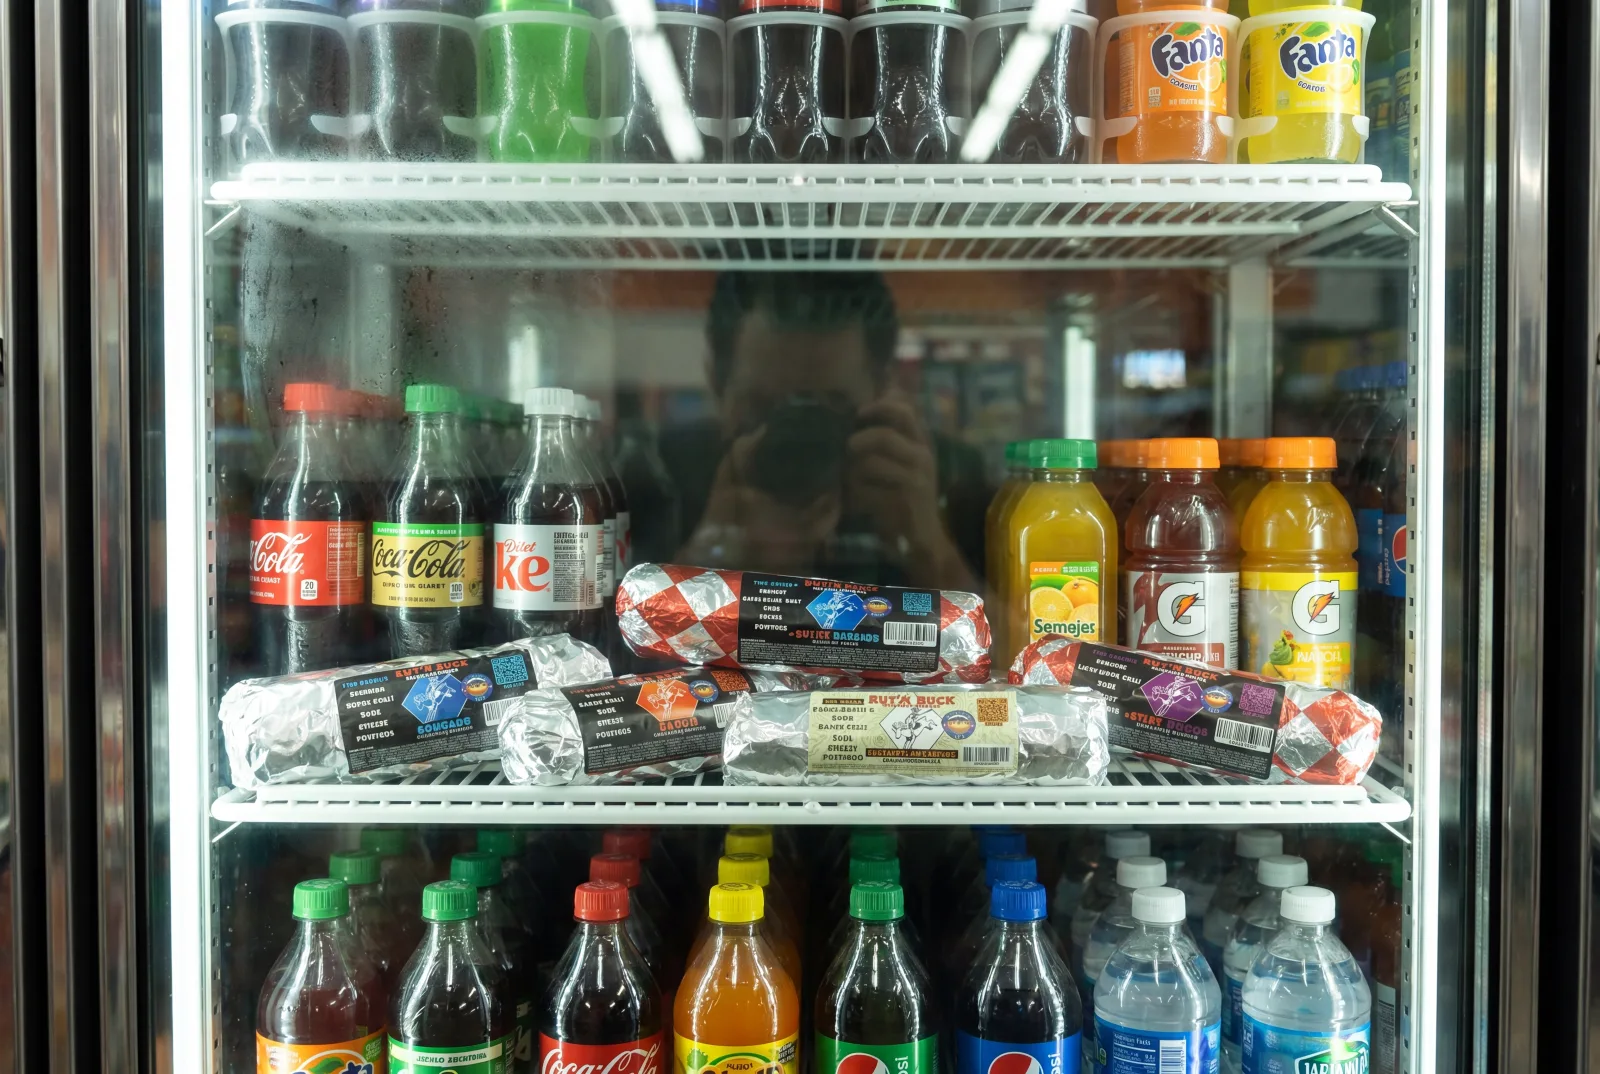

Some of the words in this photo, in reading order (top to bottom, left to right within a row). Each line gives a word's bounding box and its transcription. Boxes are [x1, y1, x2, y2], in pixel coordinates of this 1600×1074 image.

[1151, 29, 1224, 79] Fanta
[1279, 31, 1356, 79] Fanta
[372, 538, 471, 578] Coca-Cola
[305, 581, 314, 590] 20
[1157, 580, 1206, 637] G
[1291, 580, 1340, 636] G
[917, 696, 956, 705] BUCK
